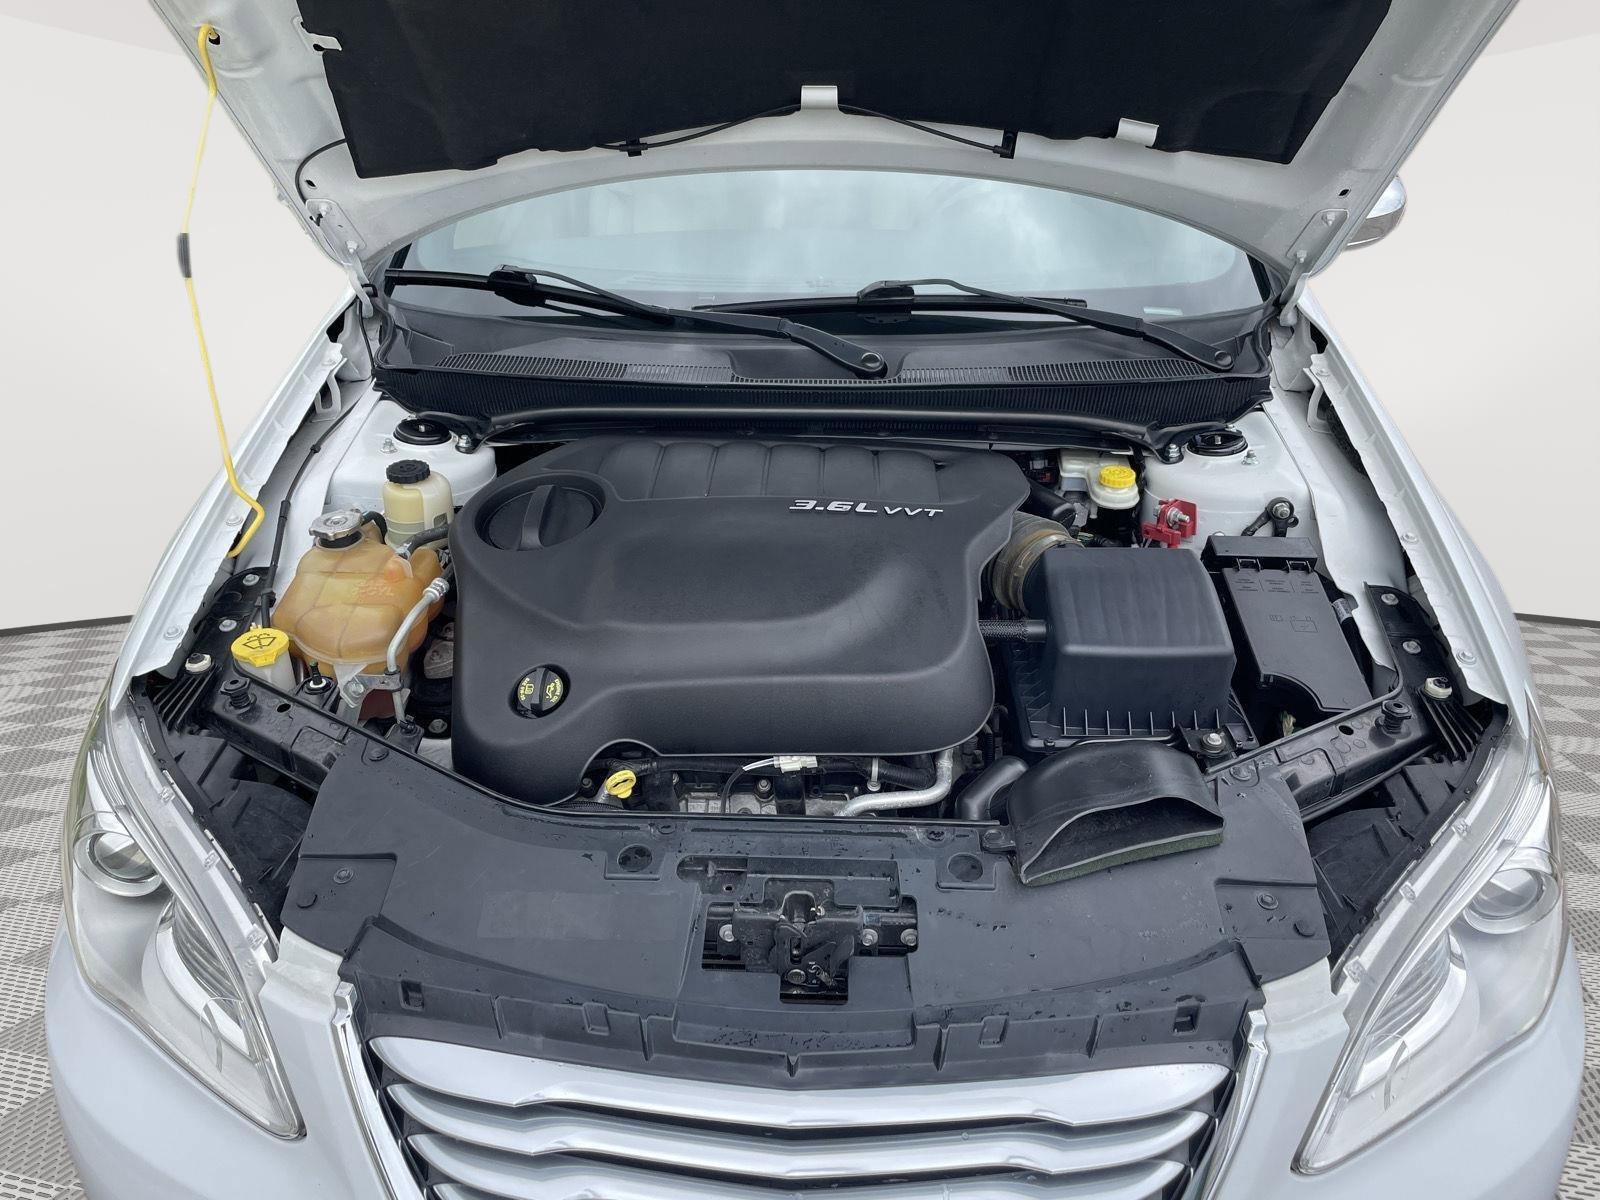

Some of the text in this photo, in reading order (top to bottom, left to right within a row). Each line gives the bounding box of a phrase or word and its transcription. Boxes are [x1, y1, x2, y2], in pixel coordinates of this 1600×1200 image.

[789, 499, 944, 517] 3.6L VVT
[549, 695, 559, 703] OIL
